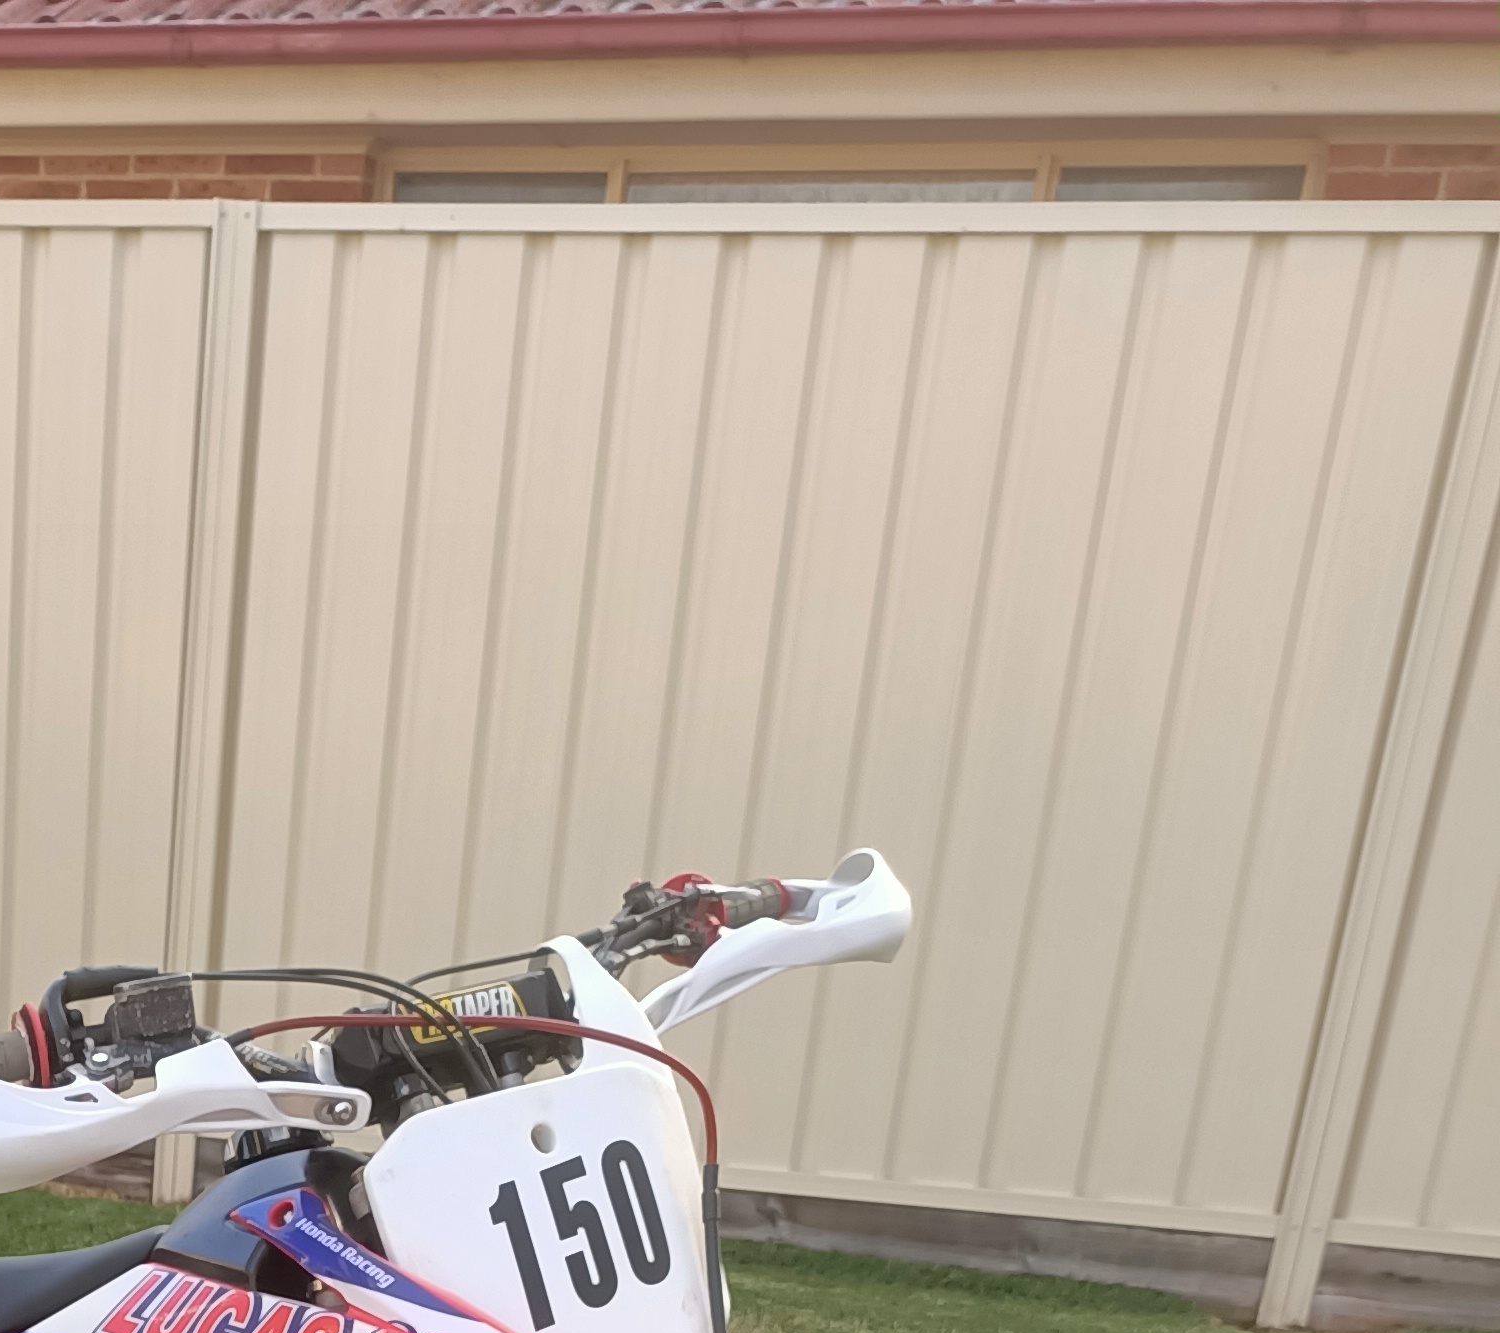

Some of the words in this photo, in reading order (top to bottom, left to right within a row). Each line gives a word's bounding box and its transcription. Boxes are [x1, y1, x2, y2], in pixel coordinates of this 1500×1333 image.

[295, 1218, 344, 1253] Honda
[340, 1246, 396, 1289] Racing
[489, 1140, 671, 1332] 150
